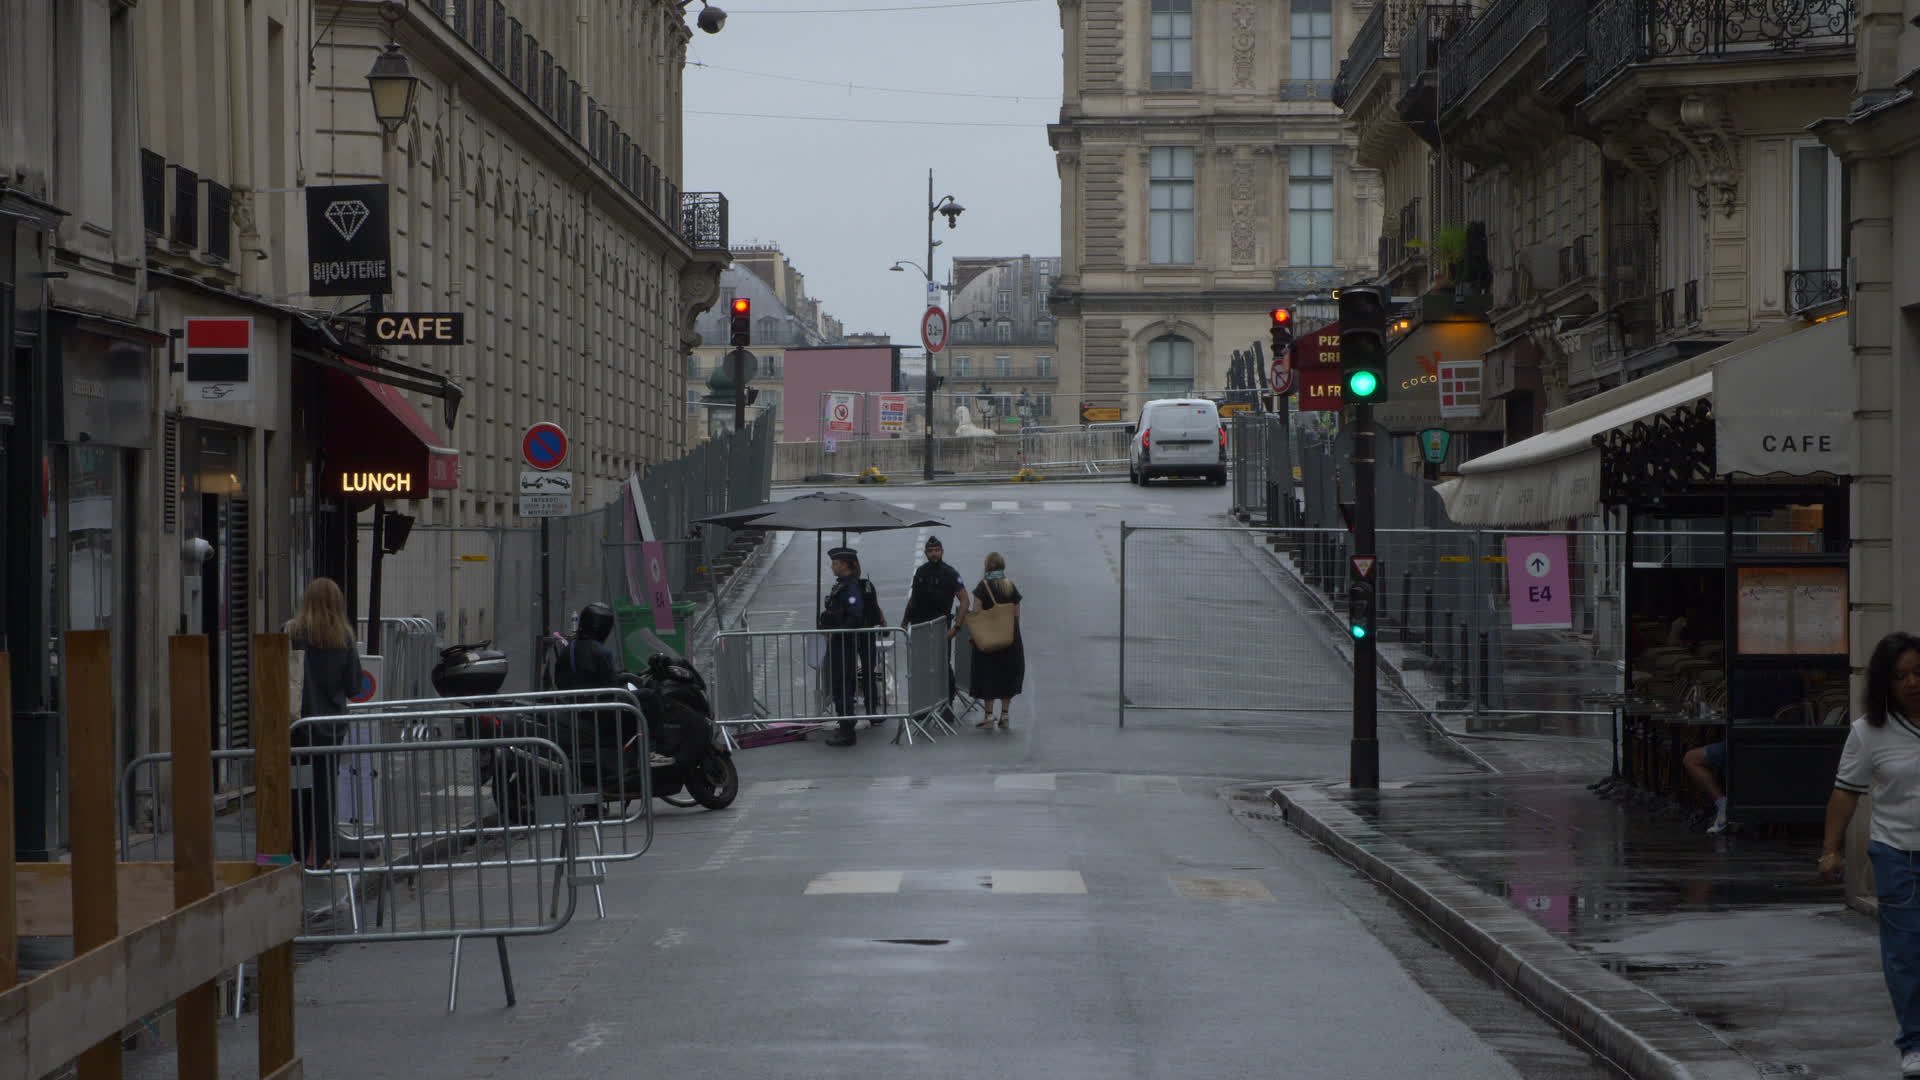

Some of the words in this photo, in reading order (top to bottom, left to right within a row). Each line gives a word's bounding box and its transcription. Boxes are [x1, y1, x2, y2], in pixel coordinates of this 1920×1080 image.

[313, 260, 387, 286] BIJOUTERIE
[376, 317, 453, 340] CAFE
[1319, 335, 1341, 346] PIZ
[1401, 375, 1438, 389] COCO
[1310, 385, 1324, 397] LA
[1328, 385, 1341, 397] FR
[1763, 435, 1831, 452] CAFE
[342, 472, 411, 492] LUNCH
[1529, 586, 1552, 602] E4
